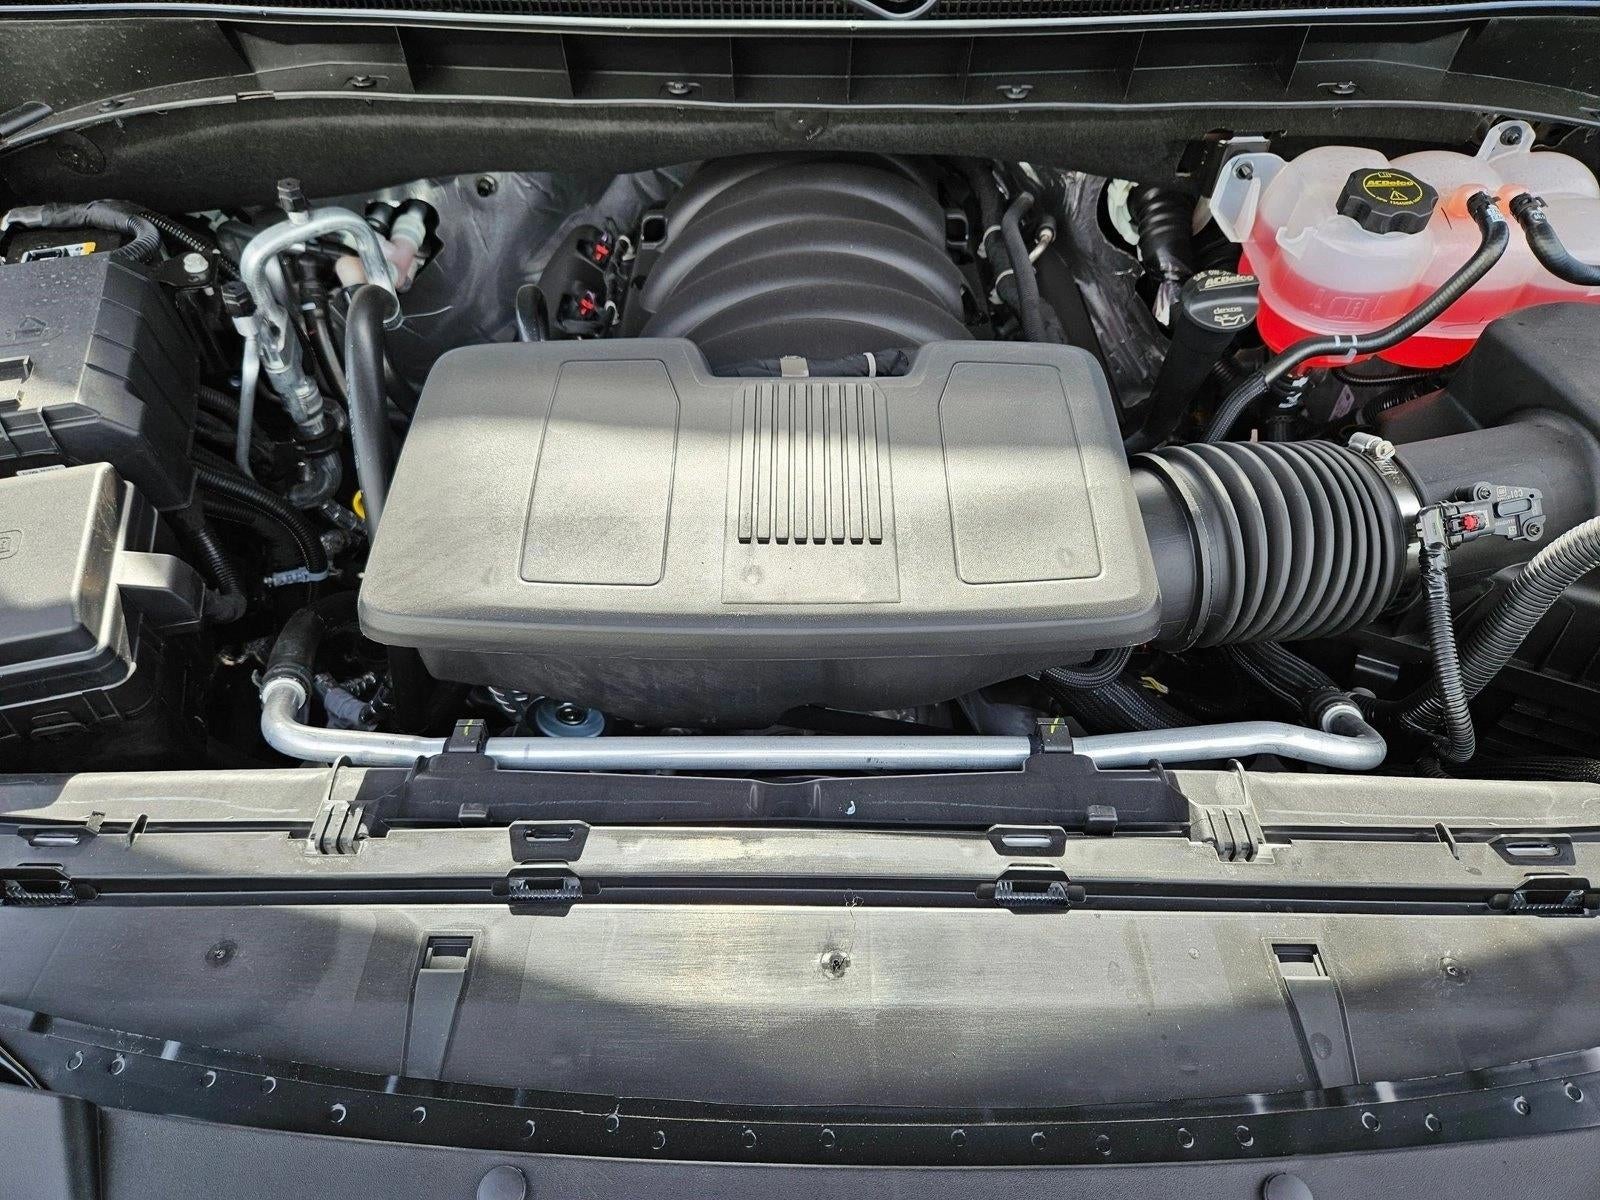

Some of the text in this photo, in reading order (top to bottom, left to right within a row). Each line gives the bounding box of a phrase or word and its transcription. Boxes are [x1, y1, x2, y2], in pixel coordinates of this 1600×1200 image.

[1365, 179, 1414, 188] ACDelco
[1204, 274, 1254, 289] ACDelco
[1213, 306, 1242, 315] dexos
